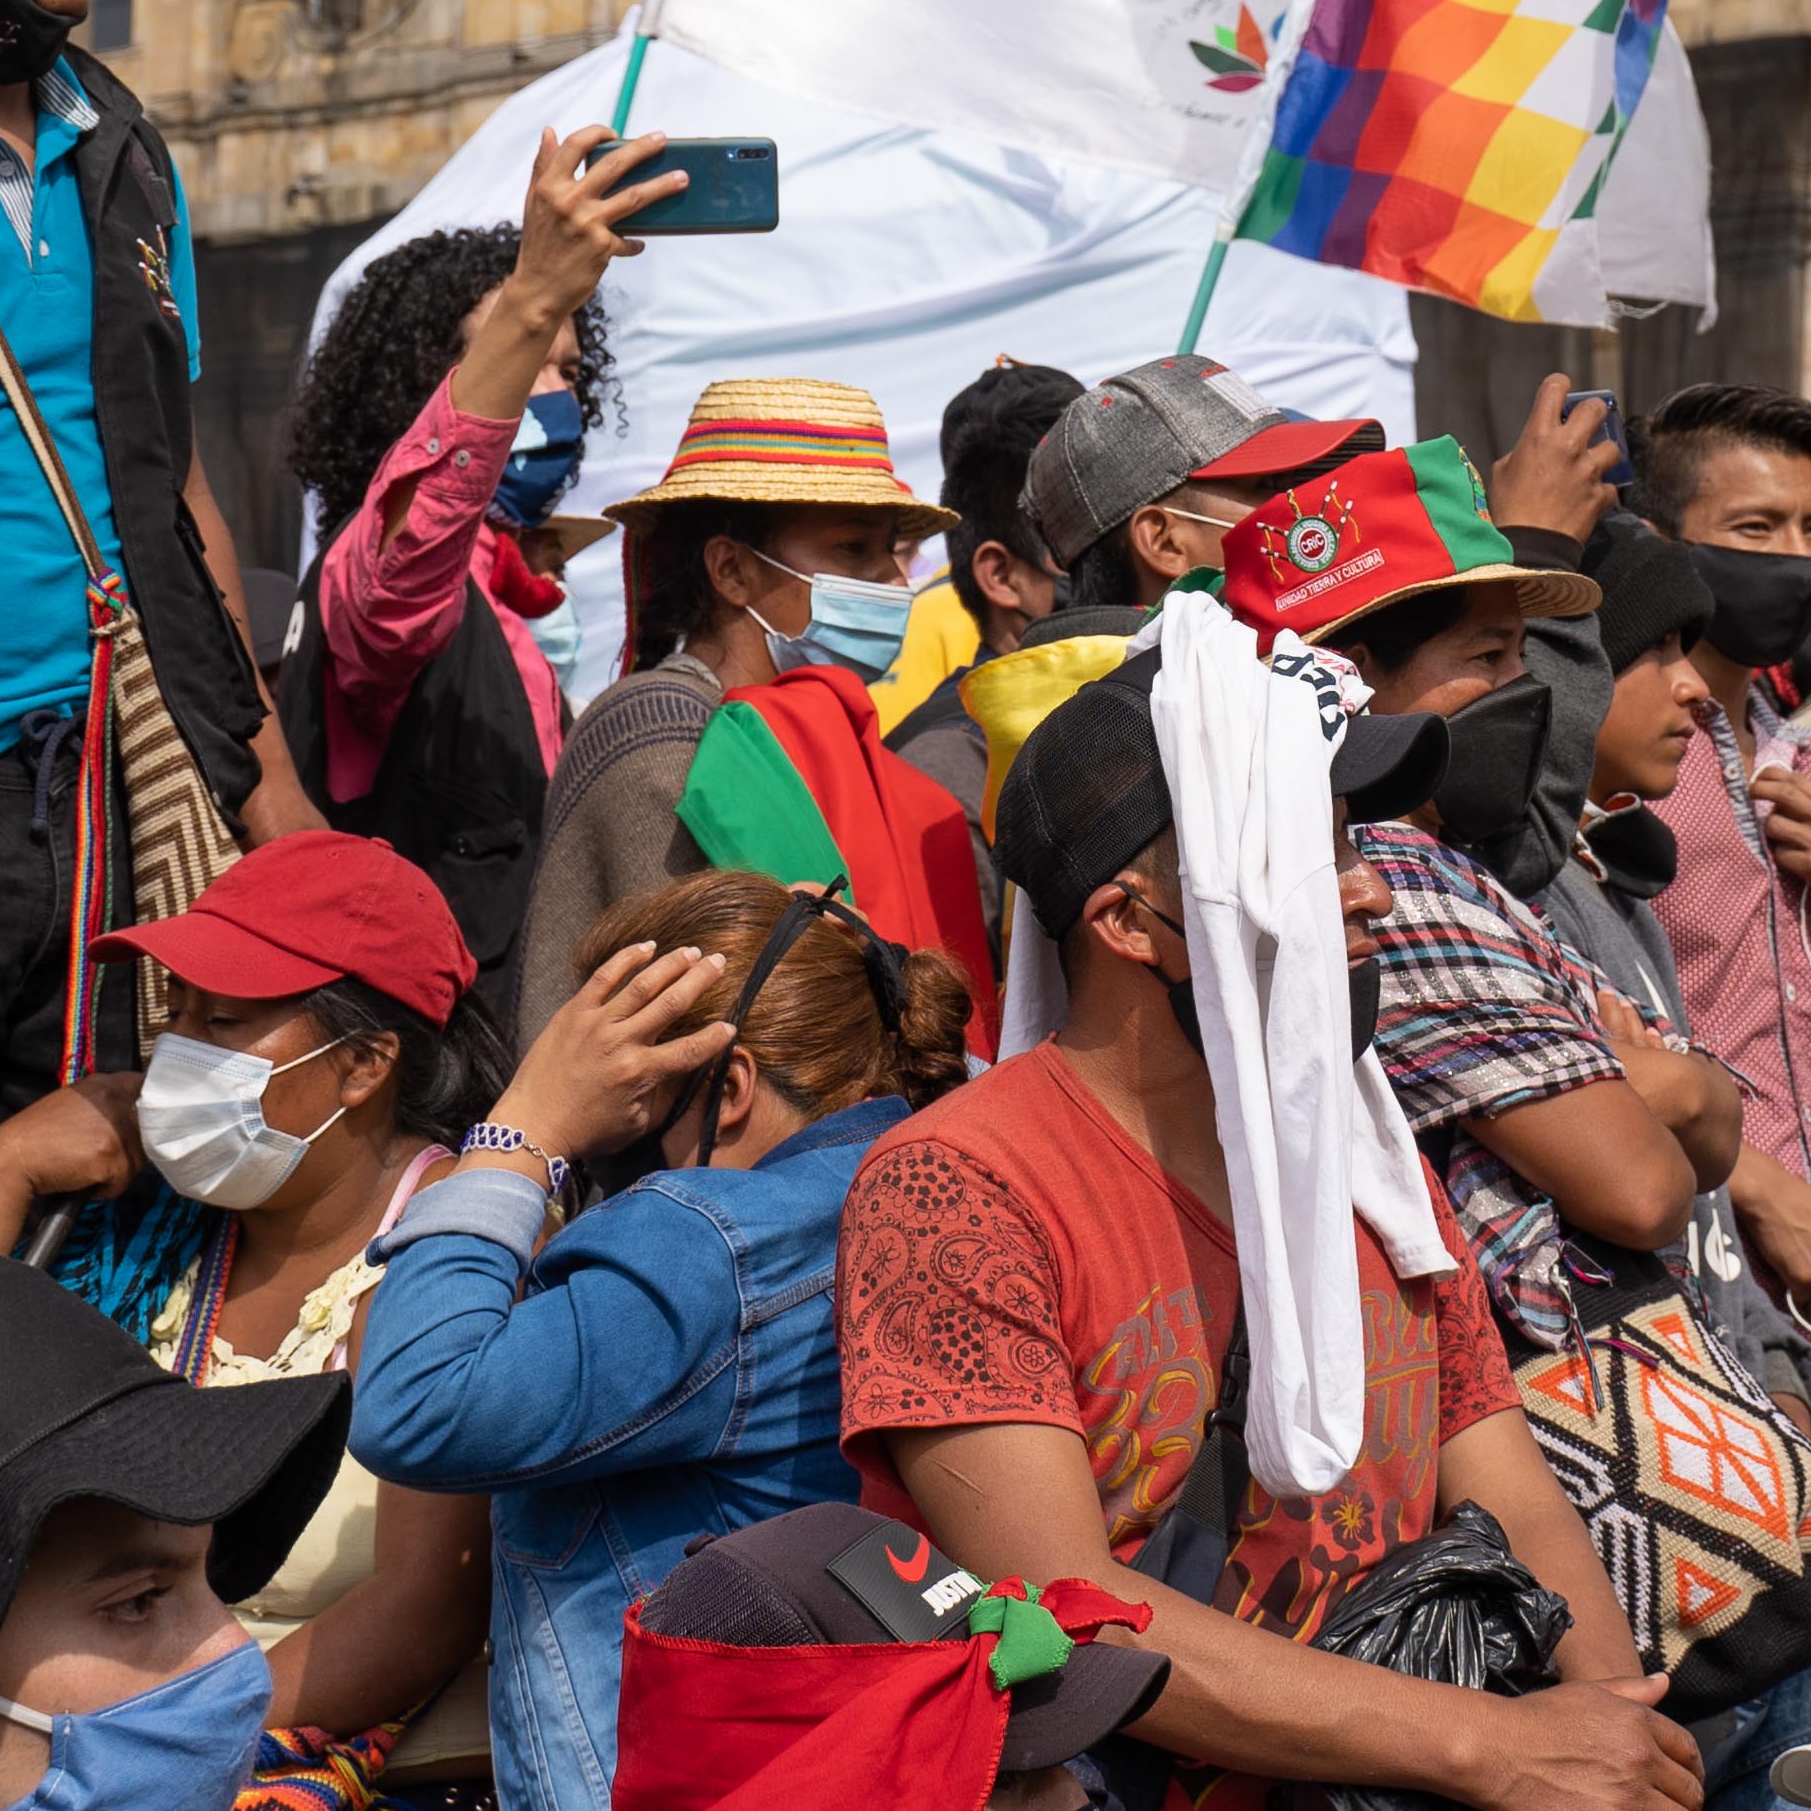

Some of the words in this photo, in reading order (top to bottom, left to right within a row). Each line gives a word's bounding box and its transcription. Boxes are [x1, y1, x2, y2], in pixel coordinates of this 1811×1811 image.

[1300, 533, 1324, 554] CRIC
[1278, 588, 1308, 609] UNIDAD
[1306, 574, 1338, 596] TIERRA
[1342, 552, 1382, 578] CULTURA
